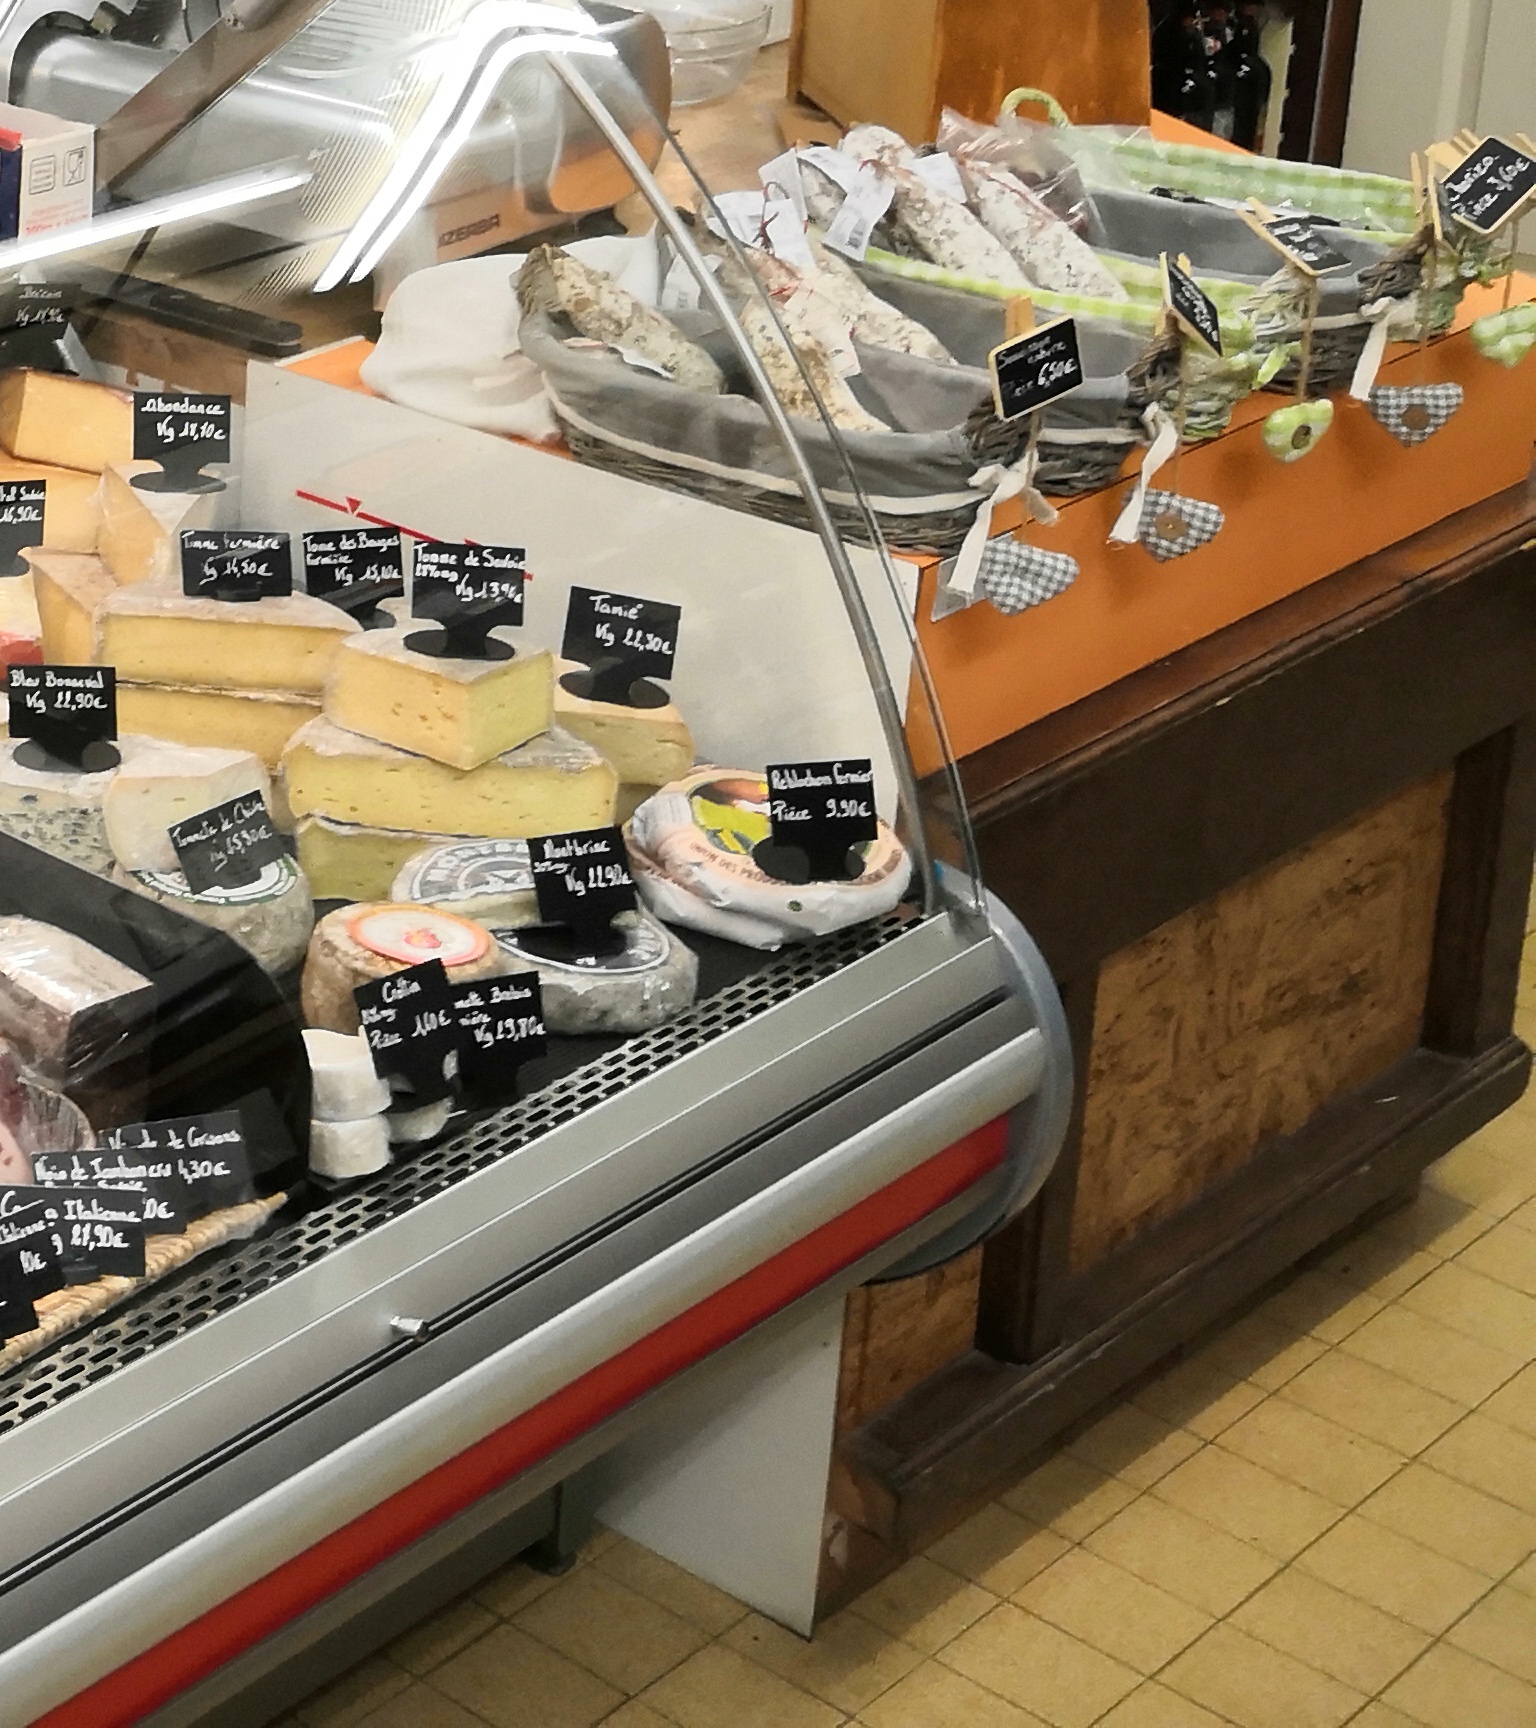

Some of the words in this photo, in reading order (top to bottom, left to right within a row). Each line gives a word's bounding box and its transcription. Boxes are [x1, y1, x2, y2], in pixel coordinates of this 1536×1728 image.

[156, 423, 175, 450] Kg
[339, 533, 357, 551] des
[357, 530, 401, 553] Bauges
[463, 548, 481, 568] de
[481, 548, 526, 571] Savoie
[334, 566, 354, 587] Kg
[454, 572, 474, 602] Kg
[588, 593, 645, 621] Tamié
[594, 622, 616, 647] Kg
[9, 669, 42, 690] Bleu
[25, 693, 47, 715] Kg
[565, 868, 588, 897] Kg
[473, 1022, 495, 1050] Kg
